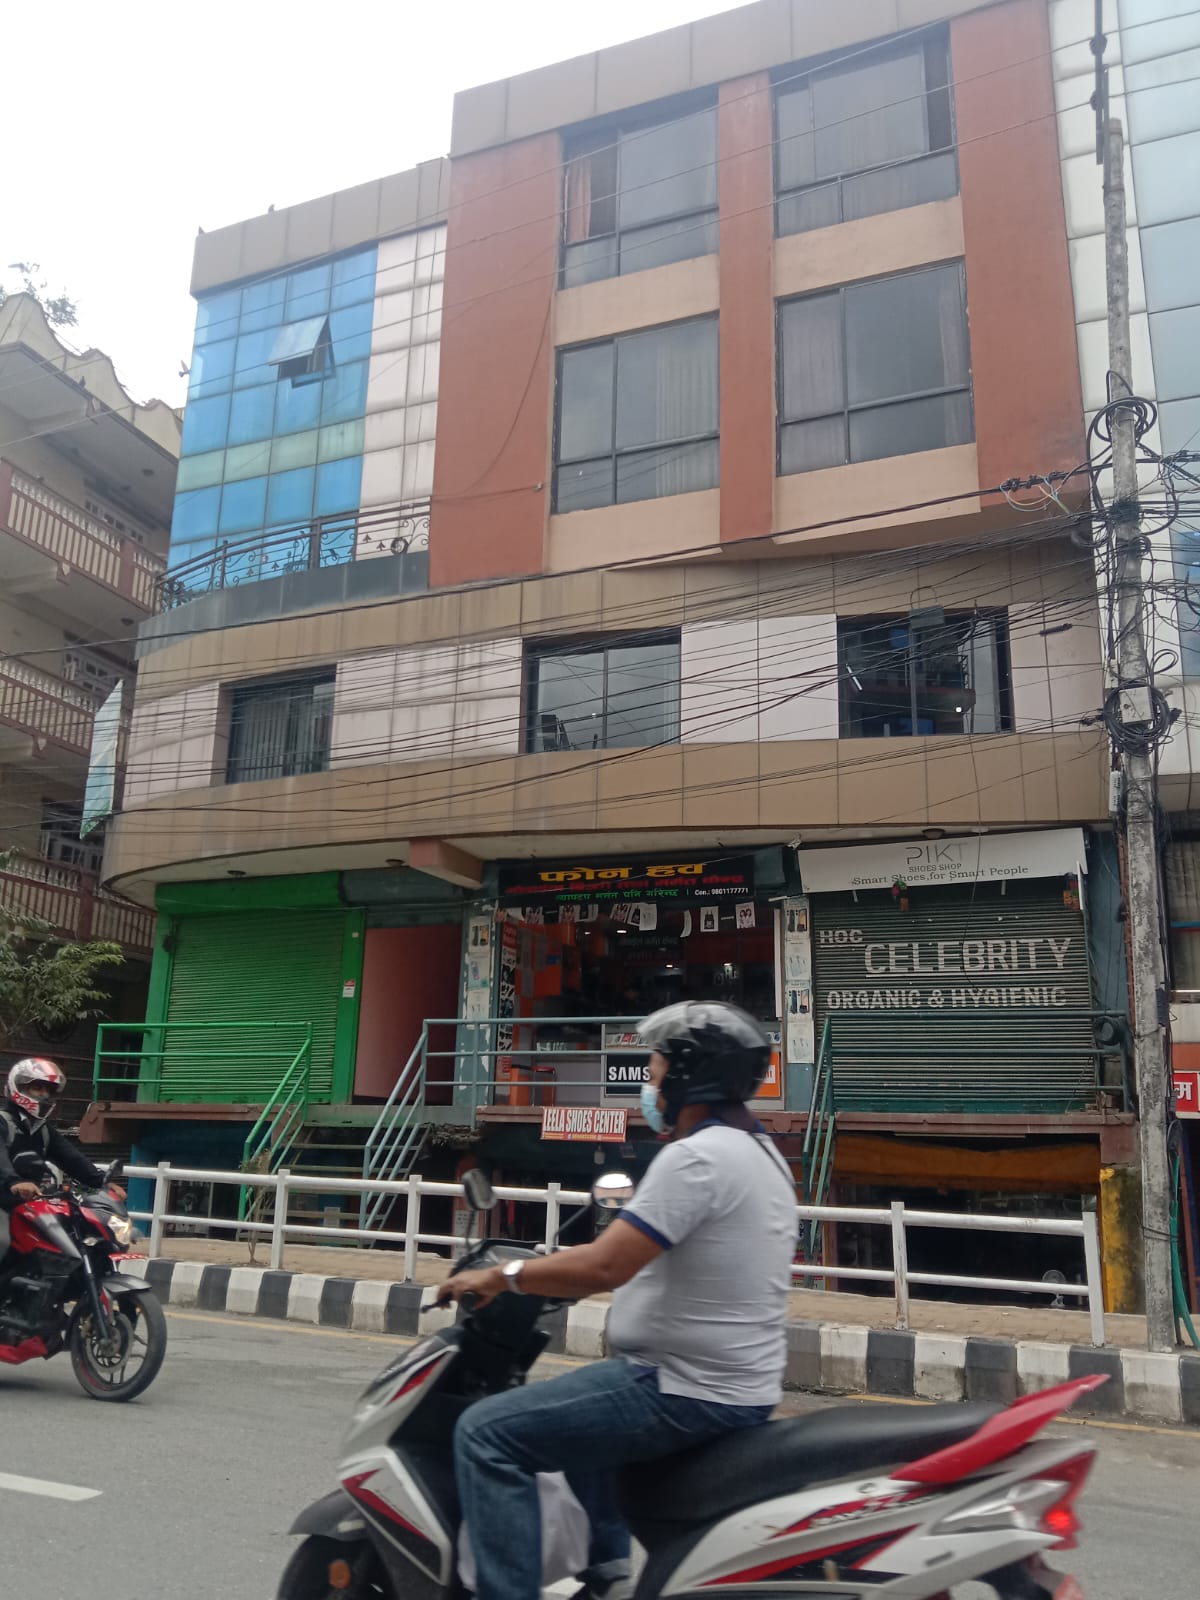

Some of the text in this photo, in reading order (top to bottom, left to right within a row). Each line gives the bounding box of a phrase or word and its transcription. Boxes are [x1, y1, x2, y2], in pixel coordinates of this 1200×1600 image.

[538, 867, 632, 882] फोन
[853, 876, 887, 885] Smart
[949, 869, 985, 879] Smart
[990, 865, 1029, 877] People
[908, 862, 962, 873] SHOES SHOP
[864, 937, 1072, 974] CELEBRITY
[827, 986, 1067, 1010] ORGANIC & HYGIENIC
[608, 1066, 651, 1081] SAMS
[543, 1108, 625, 1134] LEELA SHOES CENTER
